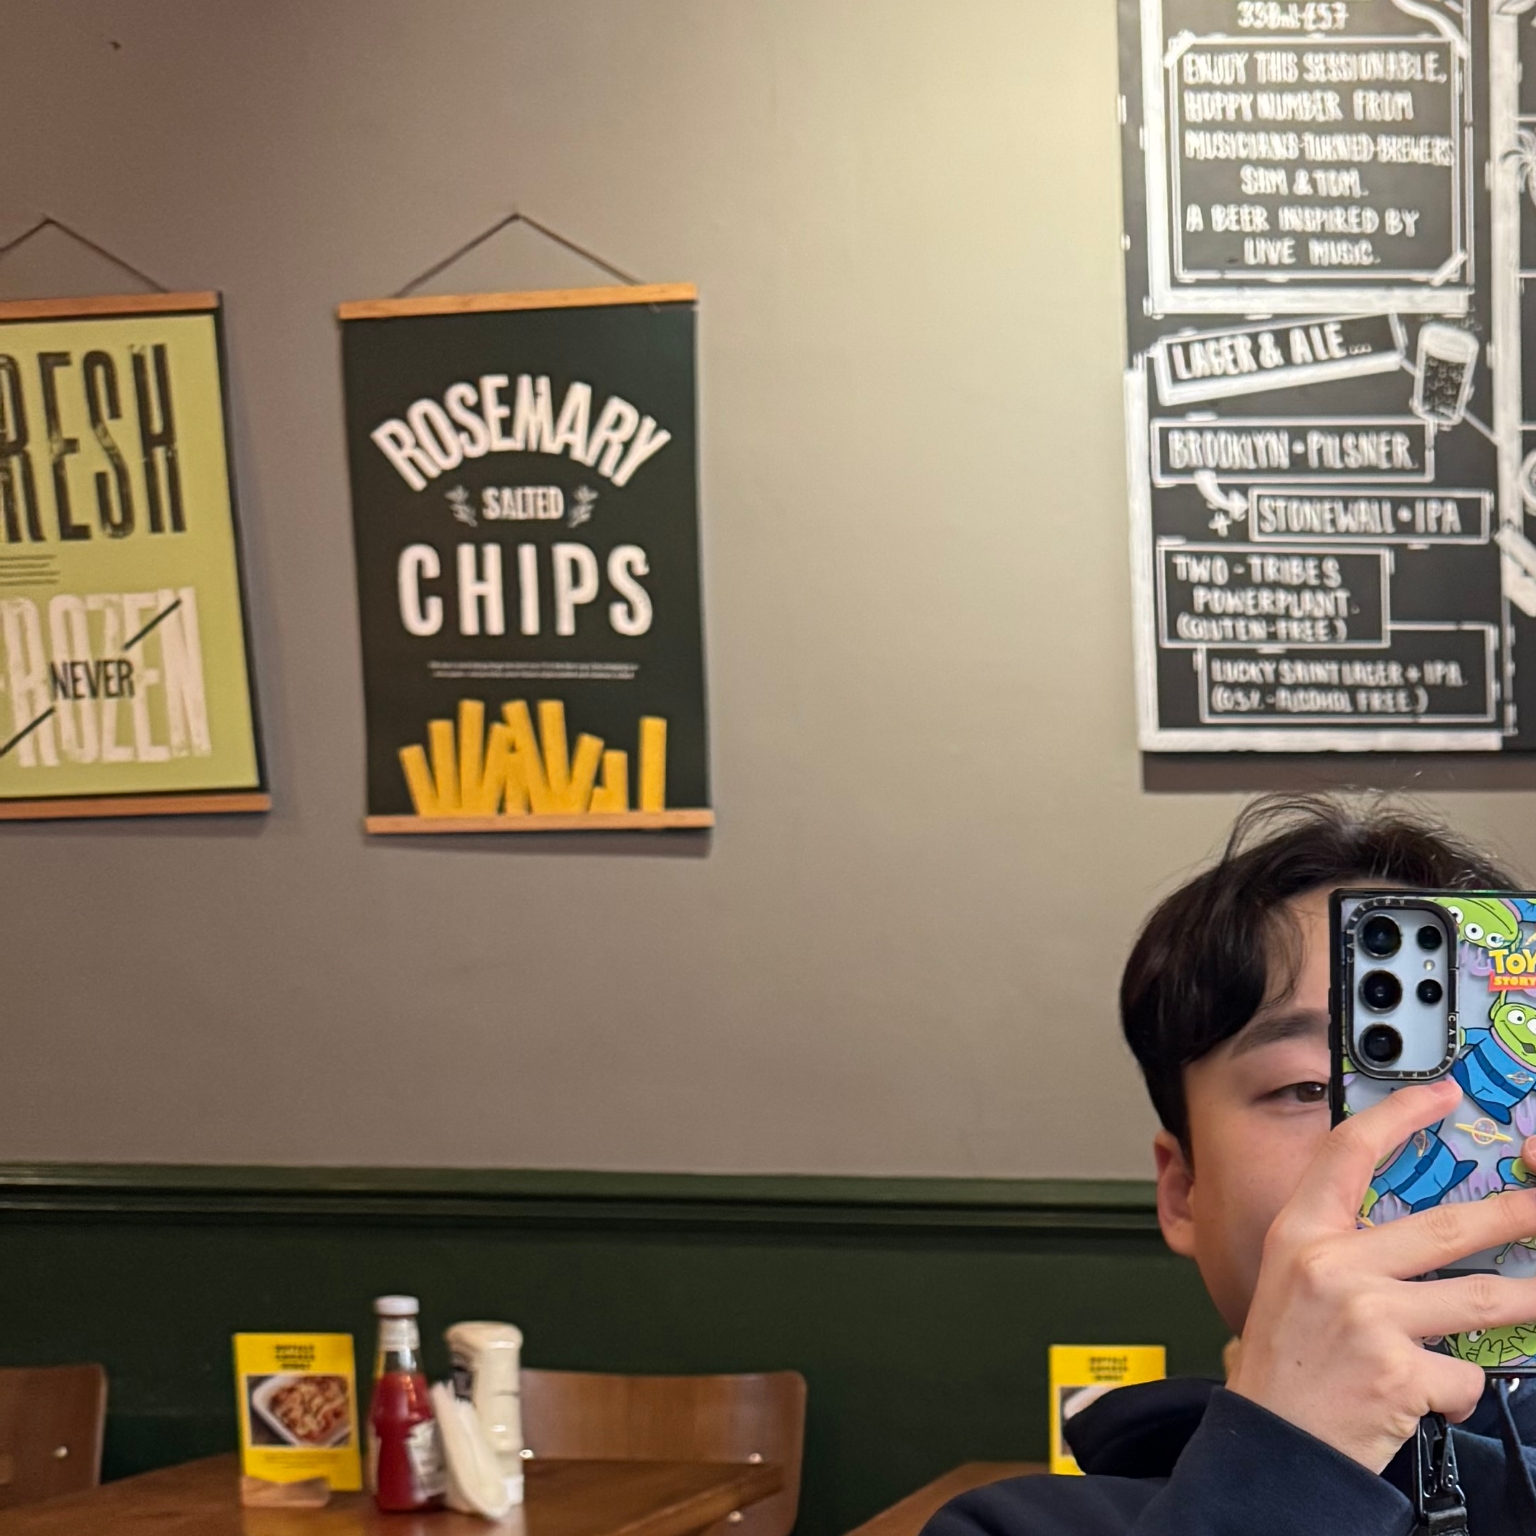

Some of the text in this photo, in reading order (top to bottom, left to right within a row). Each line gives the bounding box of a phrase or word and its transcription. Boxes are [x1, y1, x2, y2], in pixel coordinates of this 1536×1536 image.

[1183, 52, 1248, 84] ENJOY
[1254, 51, 1299, 84] THIS
[1184, 89, 1414, 122] HOPPY NUMBER FROM
[1240, 164, 1288, 195] SAM
[1293, 168, 1312, 195] &
[1185, 203, 1420, 237] A BEER INSPIRED BY
[1244, 237, 1296, 264] LIVE
[1171, 335, 1258, 379] LAGER
[1258, 331, 1285, 369] &
[371, 374, 671, 492] ROSEMARY
[1168, 430, 1290, 470] BROOKLYN
[482, 486, 564, 520] SALTED
[1259, 498, 1462, 534] STONEWALL IPA
[1172, 554, 1342, 588] TWO TRIBES
[397, 543, 653, 637] CHIPS
[50, 659, 135, 701] NEVER
[1211, 658, 1277, 684] LUCKY
[1278, 658, 1339, 685] SAINT
[1341, 660, 1405, 687] LAGER
[1275, 686, 1353, 713] ALCOHOL
